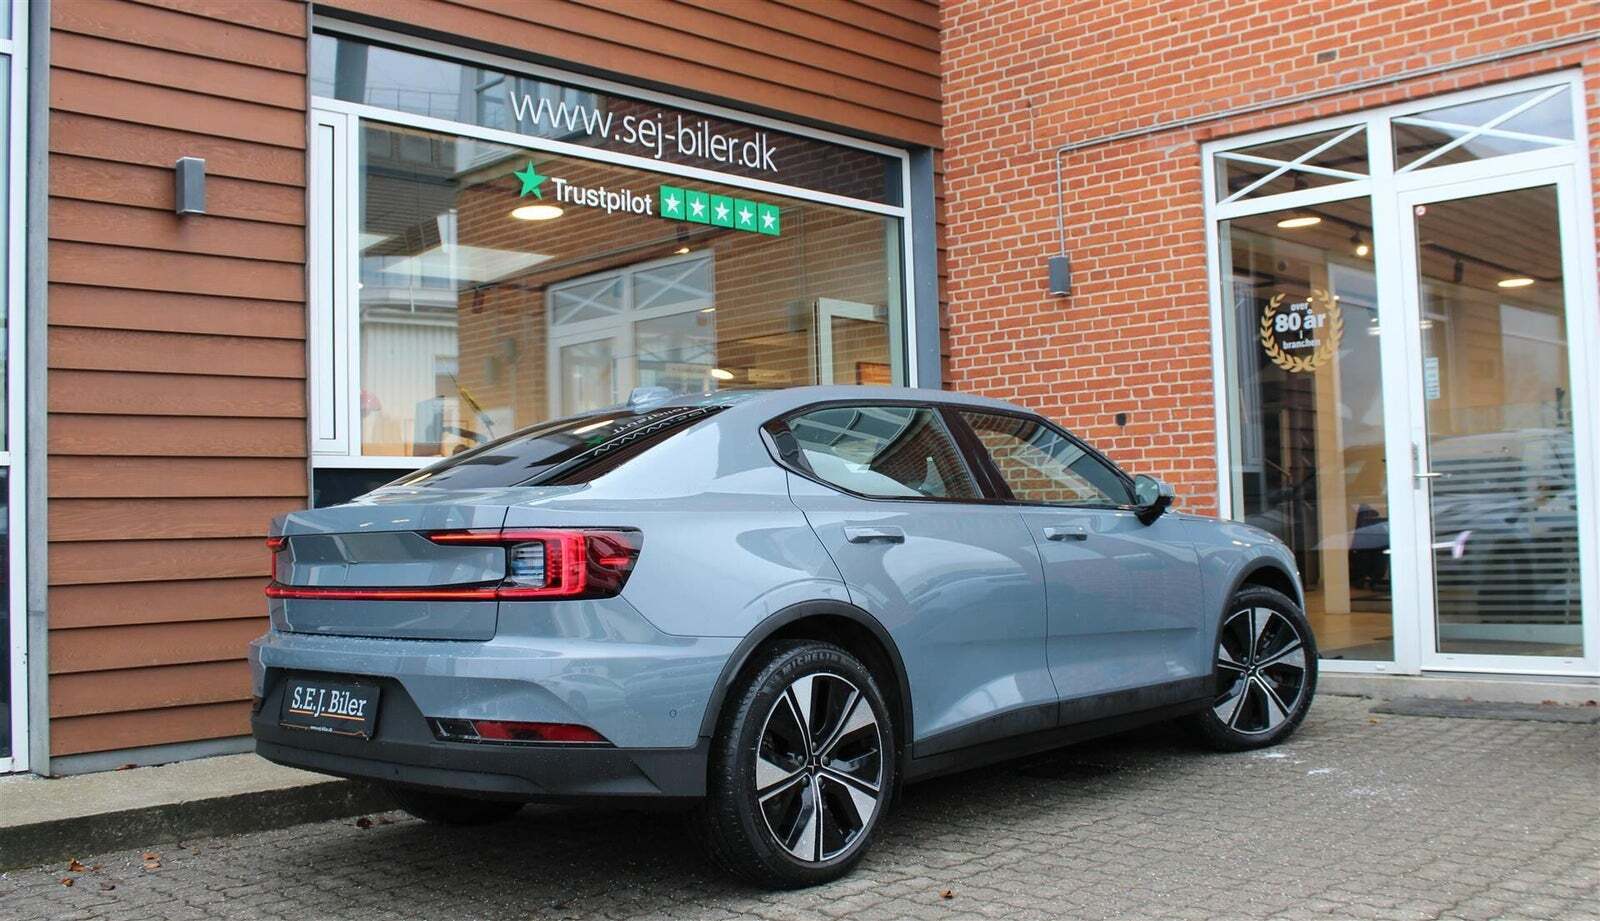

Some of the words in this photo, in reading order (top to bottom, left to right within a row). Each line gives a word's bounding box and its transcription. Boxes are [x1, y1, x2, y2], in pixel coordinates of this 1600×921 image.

[510, 91, 778, 172] www.sej-biler.dk
[551, 177, 652, 215] Trustpilot
[1275, 312, 1301, 332] 80
[1303, 309, 1326, 329] år
[1290, 303, 1309, 311] over
[292, 686, 325, 717] S.E.J.
[328, 690, 367, 716] Biler
